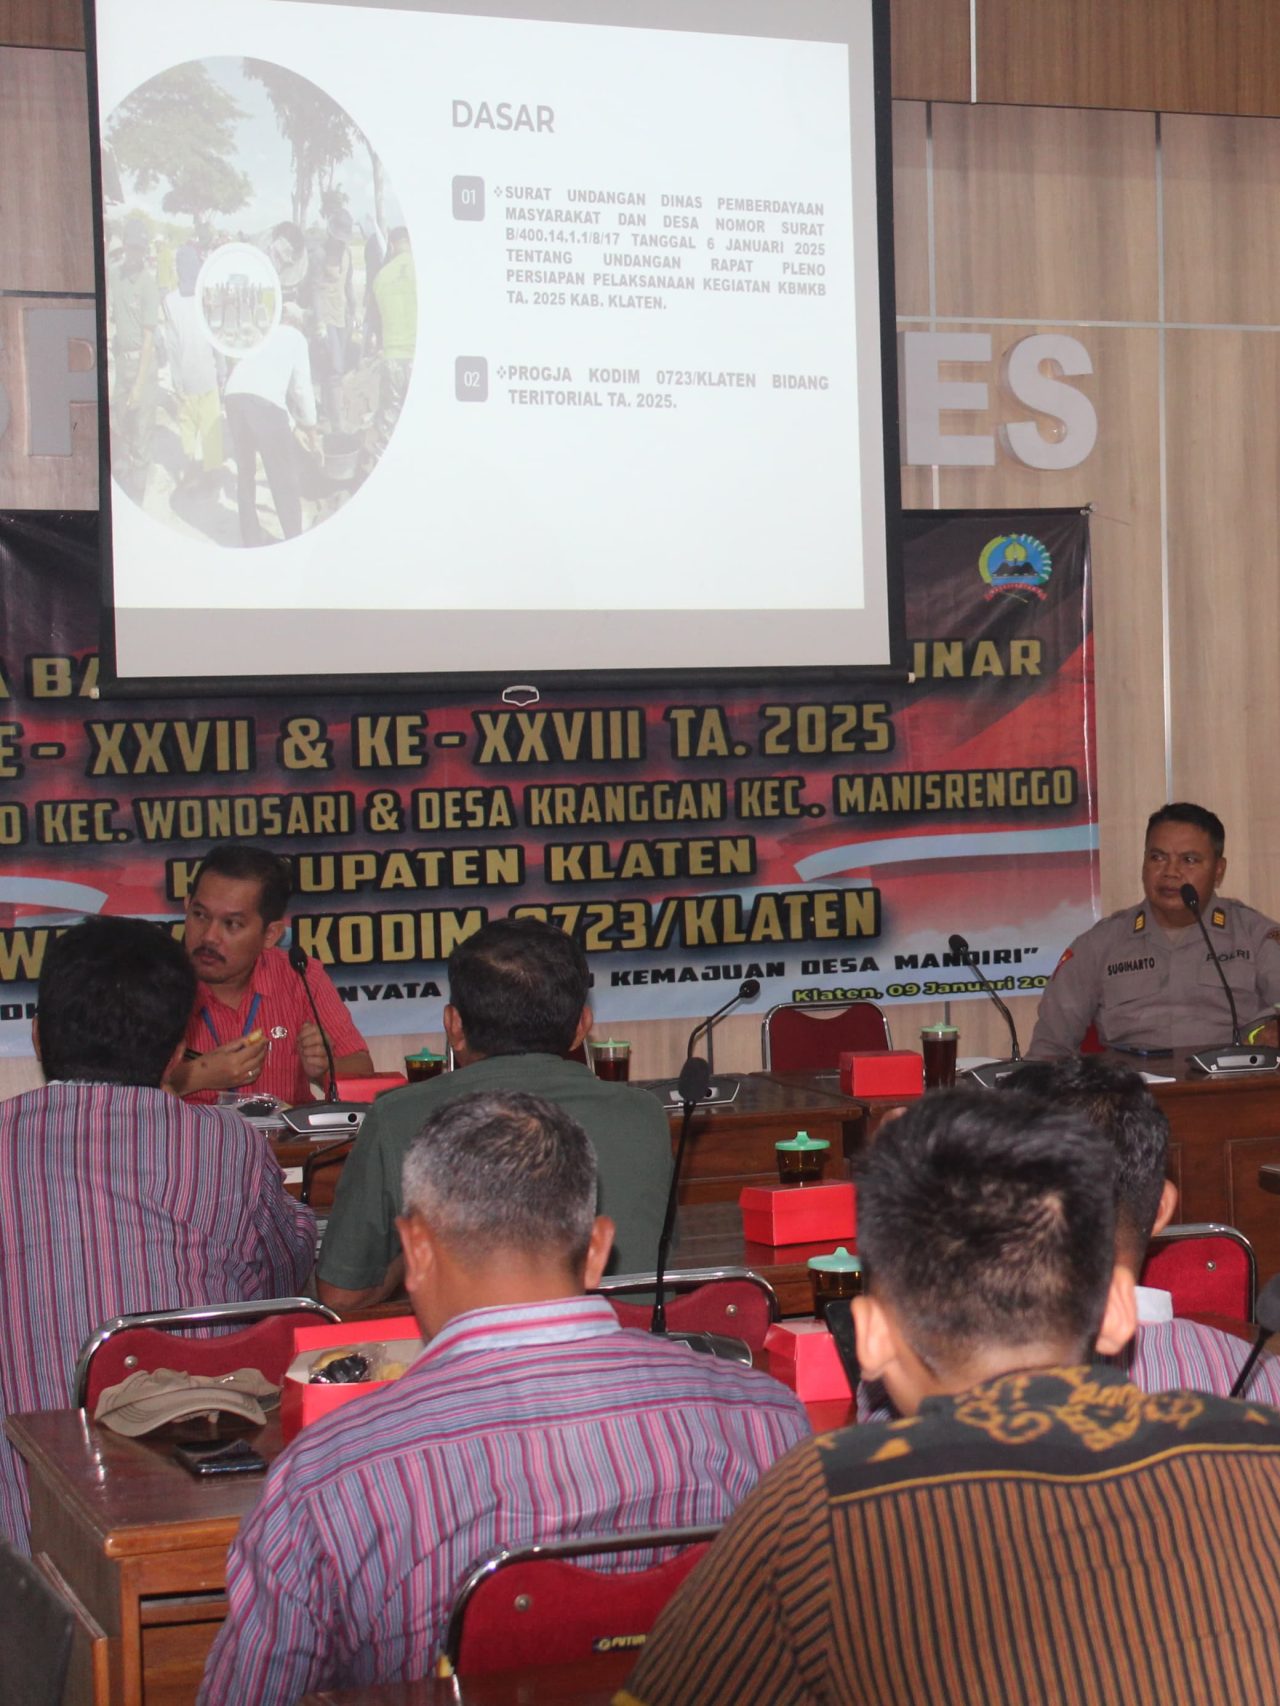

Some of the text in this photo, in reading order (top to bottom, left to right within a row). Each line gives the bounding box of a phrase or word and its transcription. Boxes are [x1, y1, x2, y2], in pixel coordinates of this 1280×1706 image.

[451, 99, 555, 134] DASAR
[462, 189, 476, 205] 01
[505, 185, 825, 217] SURAT UNDANGAN DINAS PEMBERDAYAAN
[505, 206, 825, 237] MASYARAKAT DAN DESA NOMOR SURAT
[631, 232, 697, 250] TANGGAL
[706, 236, 716, 251] 6
[725, 237, 785, 254] JANUARI
[794, 241, 826, 256] 2025
[505, 248, 826, 277] TENTANG UNDANGAN RAPAT PLENO
[506, 268, 827, 297] PERSIAPAN PELAKSANAAN KEGIATAN KBMKB
[506, 289, 667, 310] TA. 2025 KAB. KLATEN.
[464, 372, 480, 387] 02
[507, 364, 829, 391] PROGJA KODIM 0723/KLATEN BIDANG
[507, 388, 677, 409] TERITORIAL TA. 2025.
[283, 717, 328, 769] &
[670, 707, 746, 757] TA.
[765, 704, 889, 755] 2025
[43, 802, 128, 842] KEC.
[139, 795, 349, 840] WONOSARI
[369, 792, 400, 832] &
[419, 790, 511, 829] DESA
[529, 784, 721, 826] KRANGGAN
[741, 781, 820, 817] KEC.
[839, 770, 1072, 813] MANISRENGGO
[174, 839, 751, 898] KUPATEN KLATEN
[298, 907, 482, 965] KODIM
[611, 962, 785, 986] KEMAJUAN
[801, 957, 879, 976] DESA
[1107, 957, 1155, 976] SUGIHARTO
[889, 985, 919, 996] 09
[1019, 976, 1050, 989] 20
